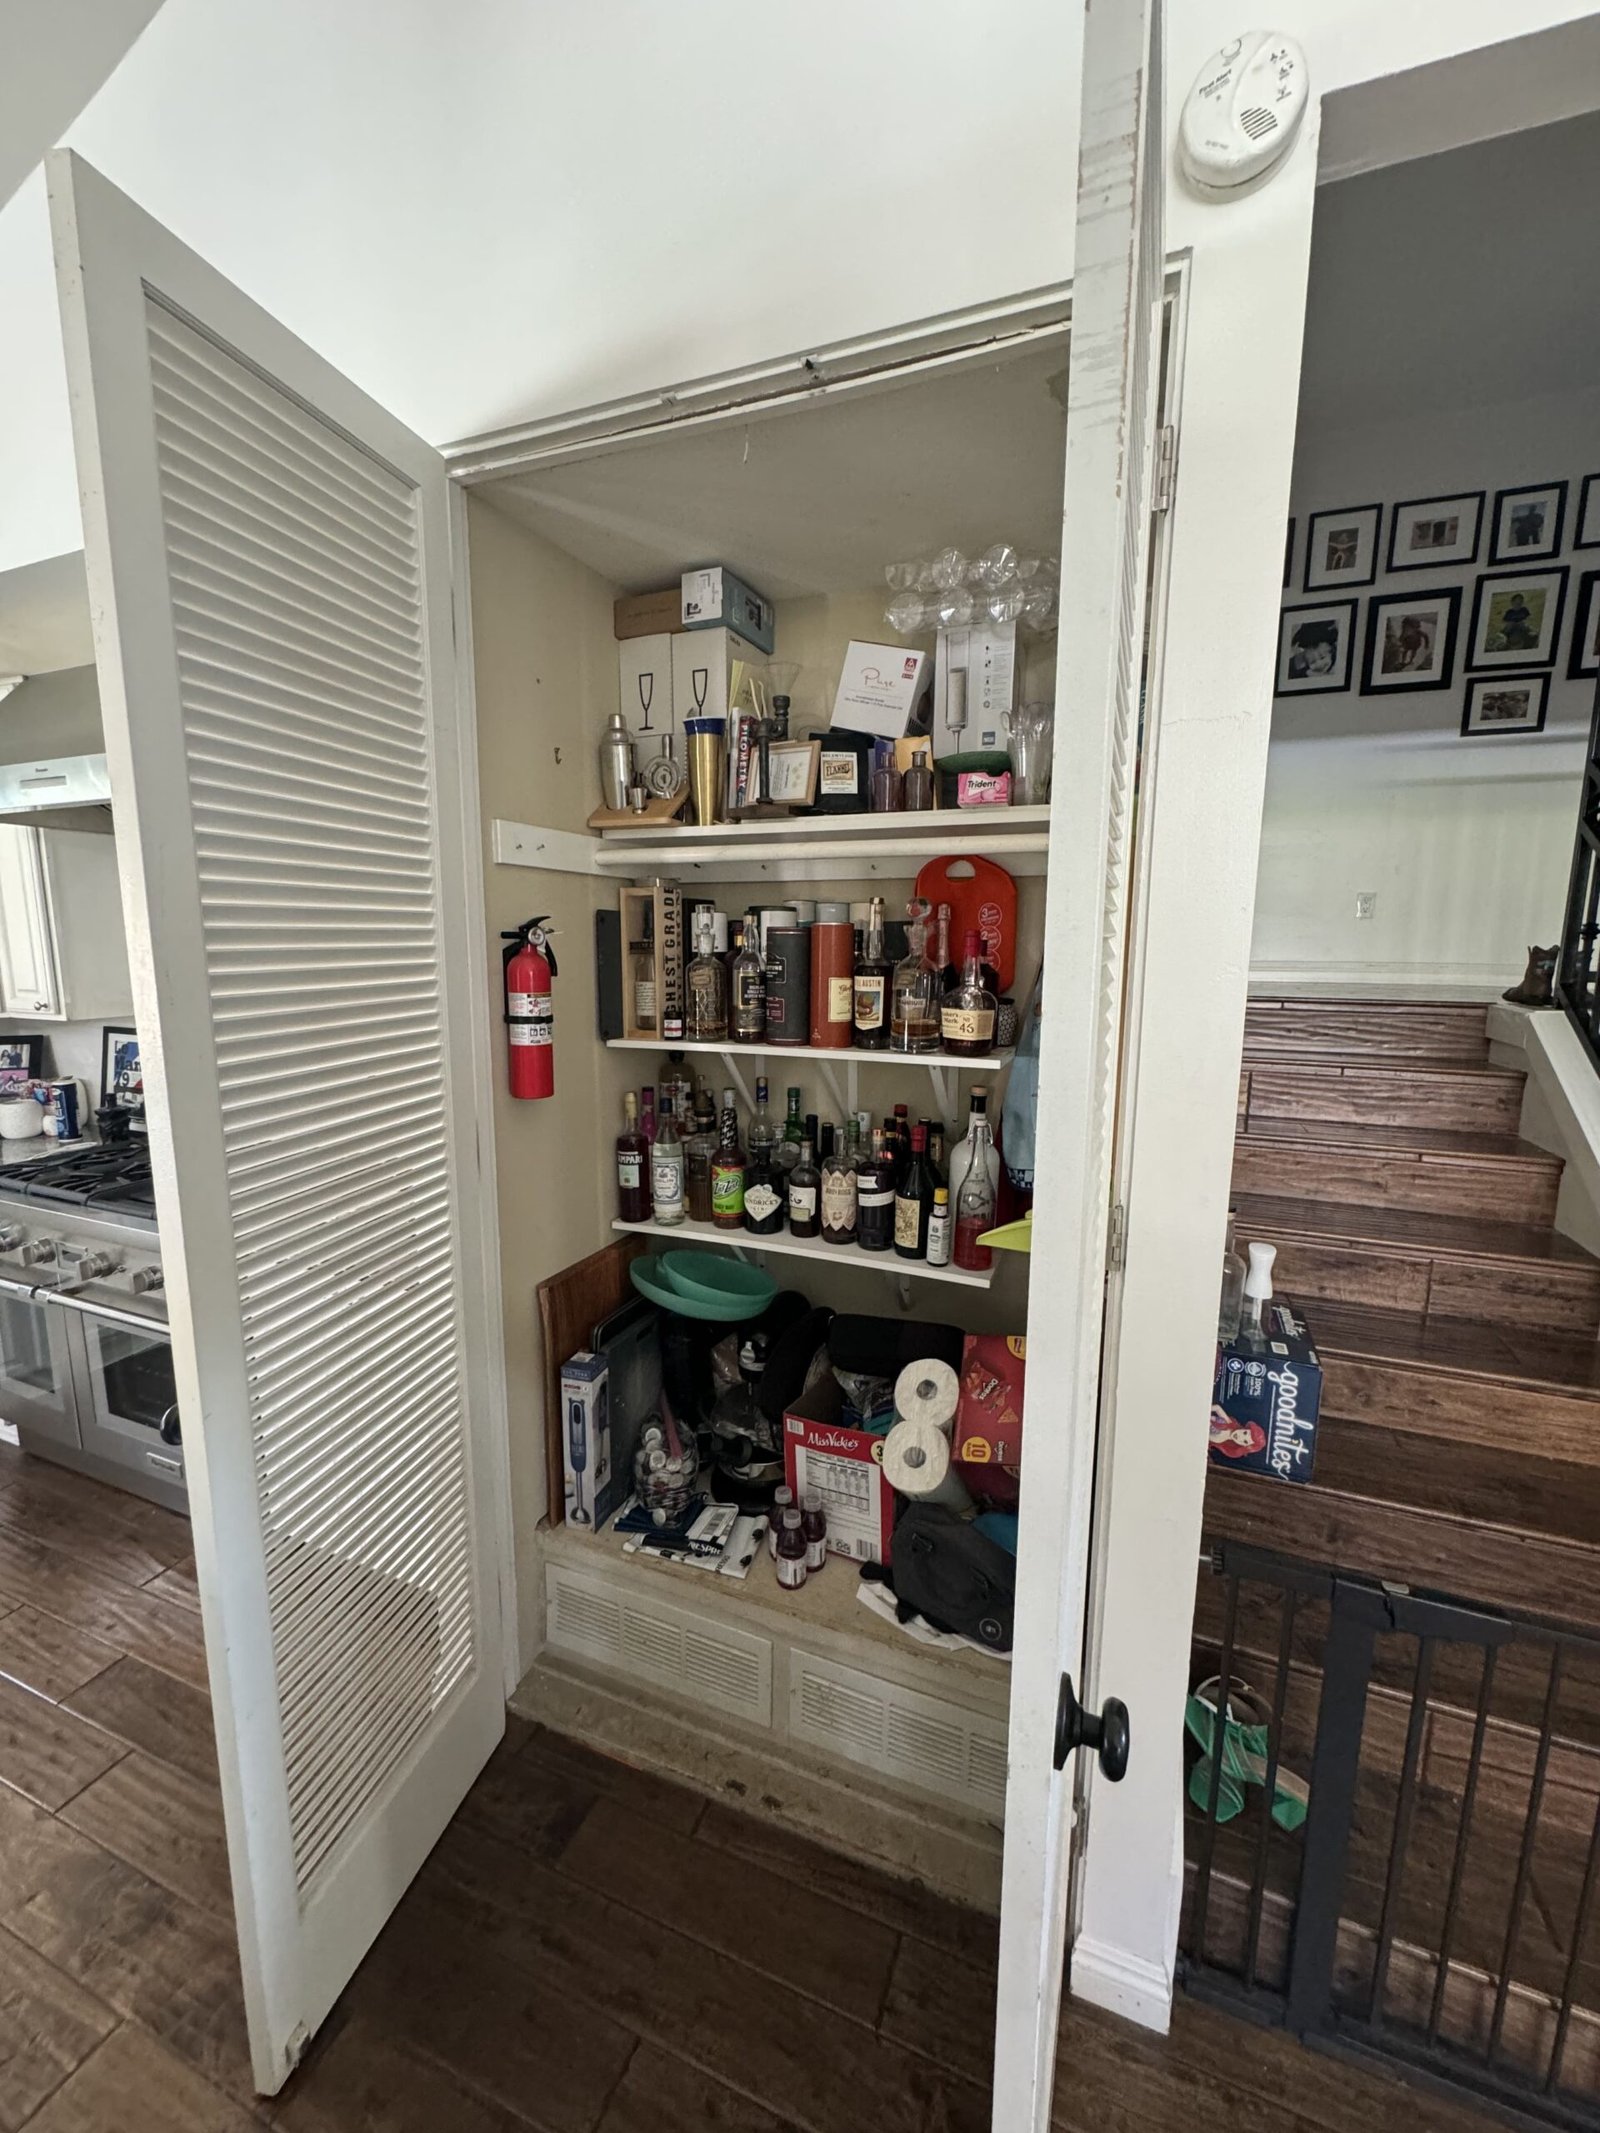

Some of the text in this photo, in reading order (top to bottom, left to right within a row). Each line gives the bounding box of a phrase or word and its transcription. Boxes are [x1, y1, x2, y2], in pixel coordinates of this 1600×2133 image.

[664, 886, 676, 949] GRADE
[665, 955, 677, 1013] GHEST
[959, 1022, 975, 1034] 46
[617, 1154, 643, 1164] AMPARI
[1267, 1361, 1314, 1481] goodnites
[807, 1431, 859, 1451] Miss Vickie's
[971, 1443, 987, 1459] 10
